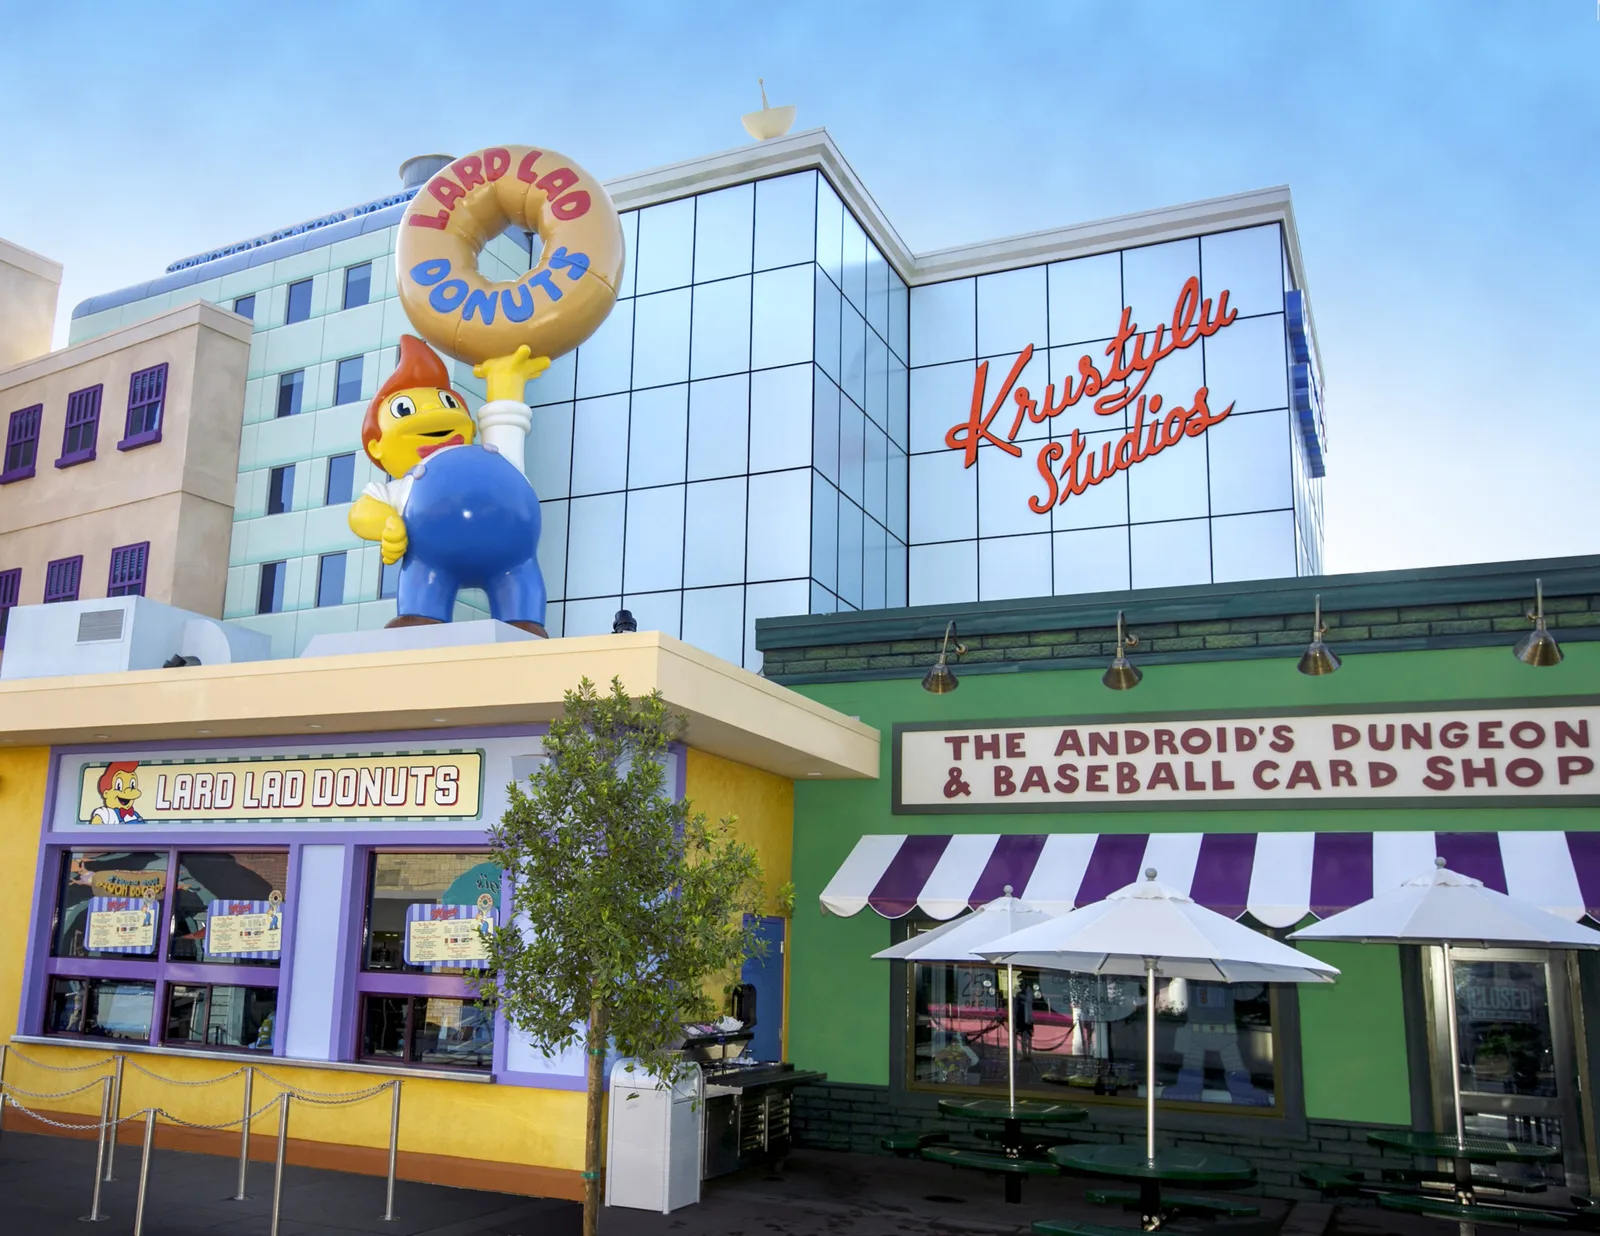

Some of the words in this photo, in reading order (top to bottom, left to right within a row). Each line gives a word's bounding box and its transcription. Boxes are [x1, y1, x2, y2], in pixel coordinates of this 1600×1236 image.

[409, 147, 511, 231] LARD
[517, 150, 592, 221] LAD
[409, 246, 591, 326] DONUTS
[944, 275, 1239, 469] Krustylu
[1027, 386, 1236, 515] Studios
[944, 731, 1027, 761] THE
[1053, 724, 1295, 757] ANDROID'S
[1331, 719, 1590, 752] DUNGEON
[155, 771, 236, 811] LARD
[242, 768, 306, 810] LAD
[312, 764, 461, 808] DONUTS
[943, 766, 972, 799] &
[993, 760, 1235, 797] BASEBALL
[1252, 758, 1398, 791] CARD
[1421, 755, 1595, 791] SHOP
[1471, 985, 1532, 1011] CLOSED
